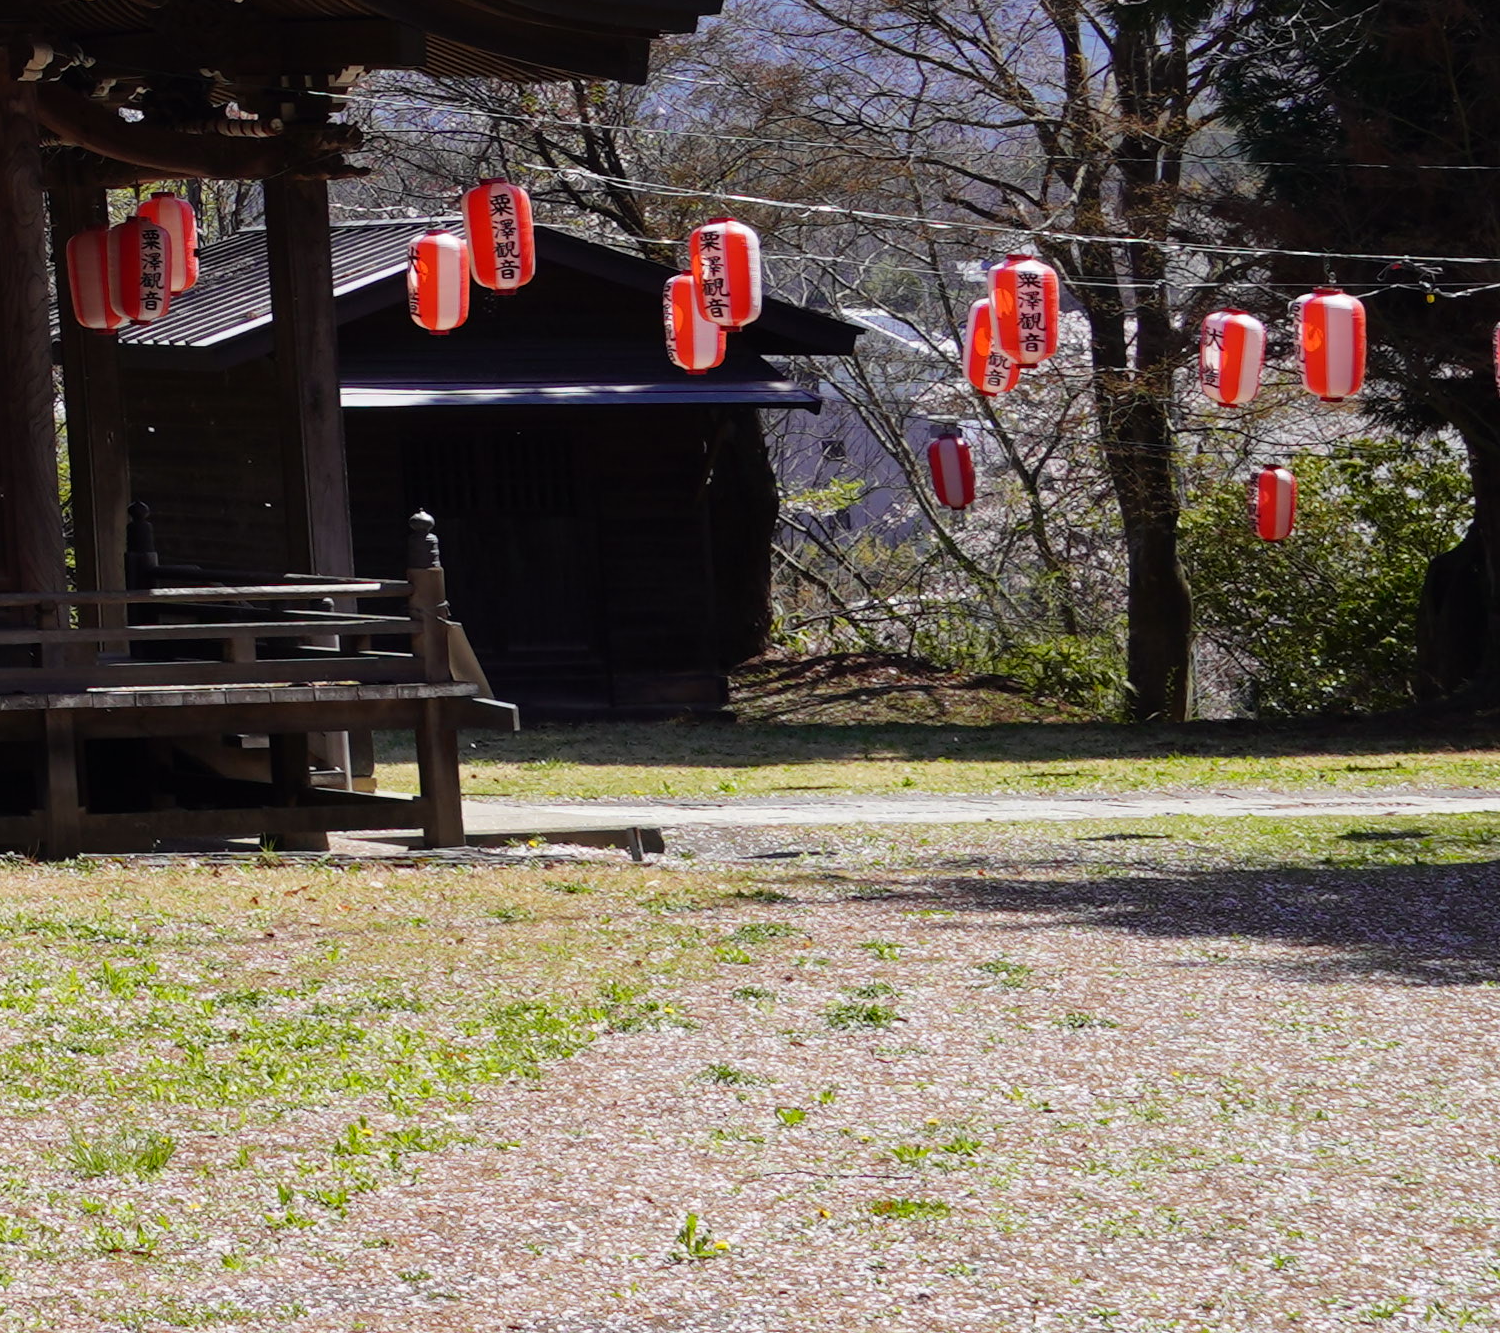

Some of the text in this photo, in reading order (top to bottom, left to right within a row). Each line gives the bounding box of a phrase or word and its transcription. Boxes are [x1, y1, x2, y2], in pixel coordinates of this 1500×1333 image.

[140, 229, 164, 311] 粟澤観音
[490, 193, 521, 280] 粟澤観音
[700, 231, 731, 318] 粟澤観音
[1017, 272, 1047, 353] 粟澤観音
[985, 350, 1011, 387] 観音
